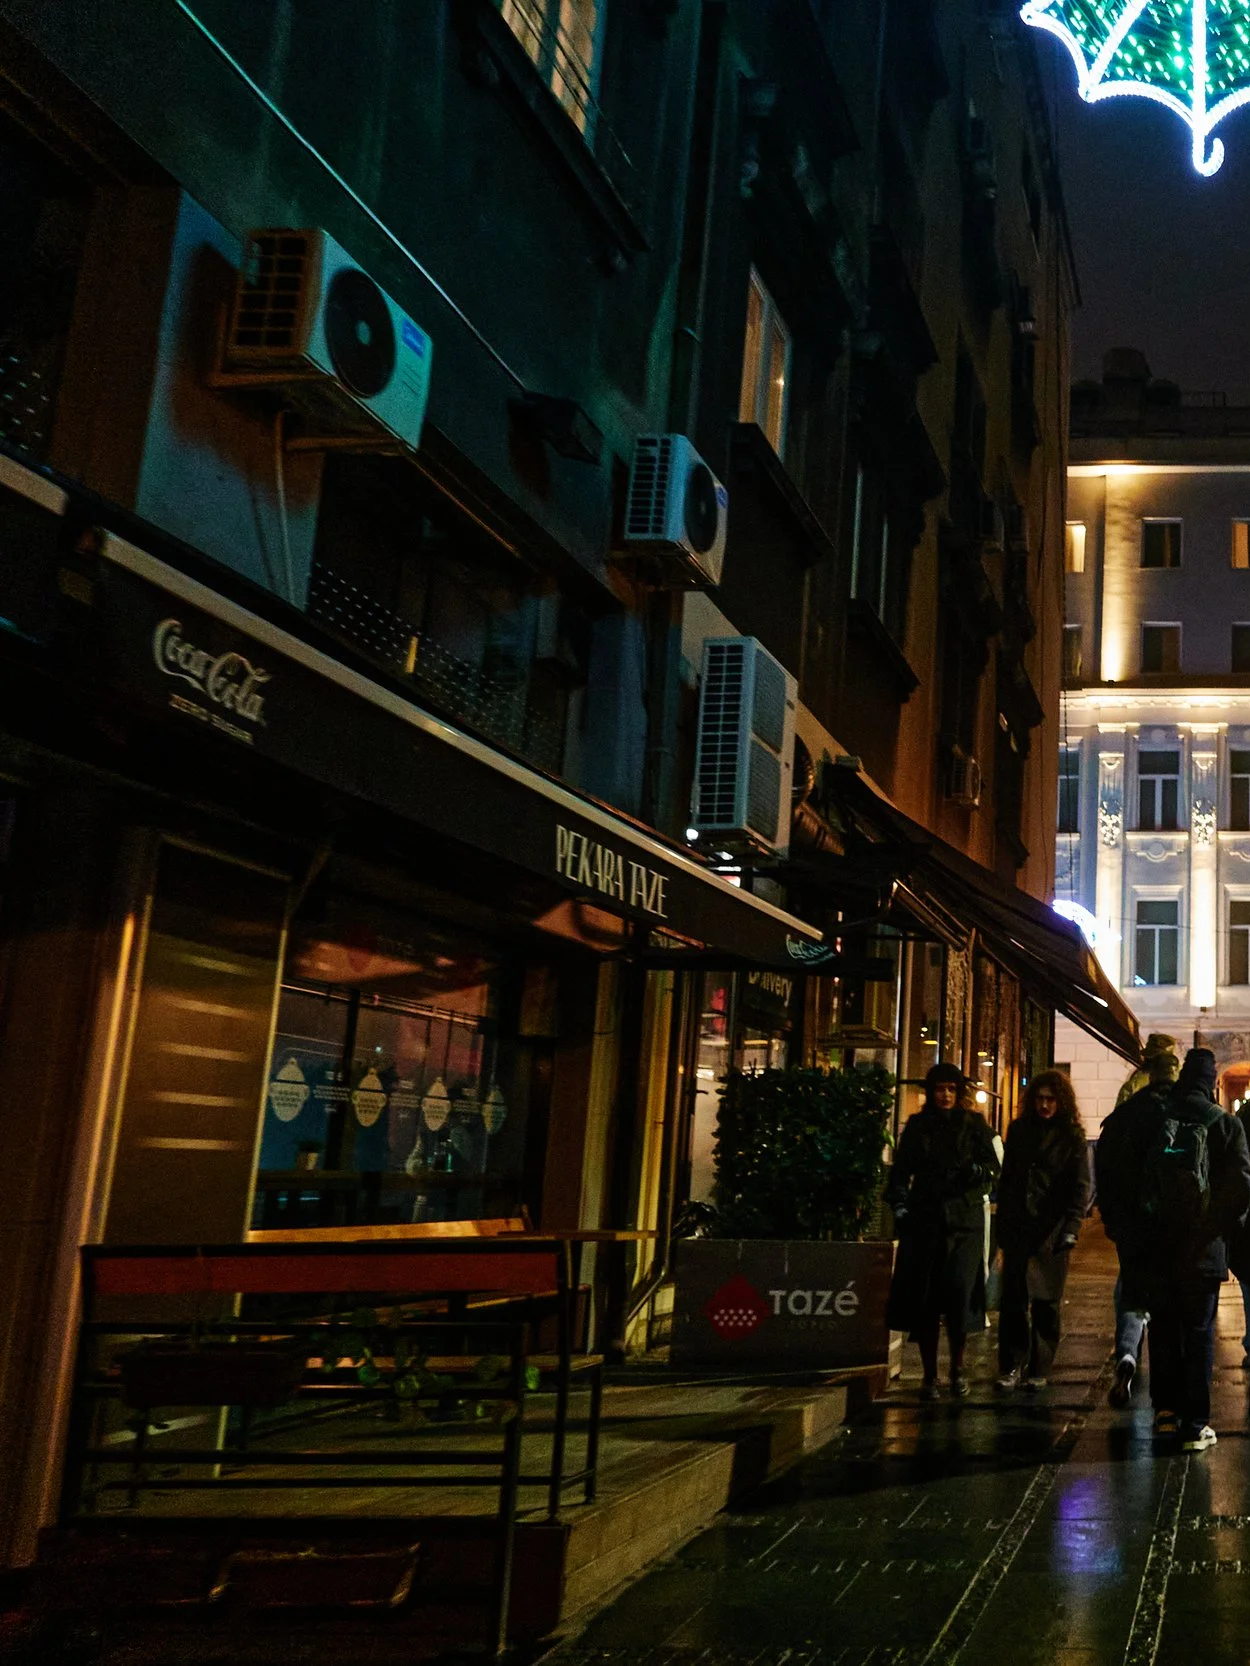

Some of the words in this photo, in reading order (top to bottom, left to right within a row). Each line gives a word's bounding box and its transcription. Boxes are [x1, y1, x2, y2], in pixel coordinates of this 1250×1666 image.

[555, 823, 625, 902] PEKARA
[627, 860, 670, 919] TAZE
[768, 1280, 860, 1317] Tazé
